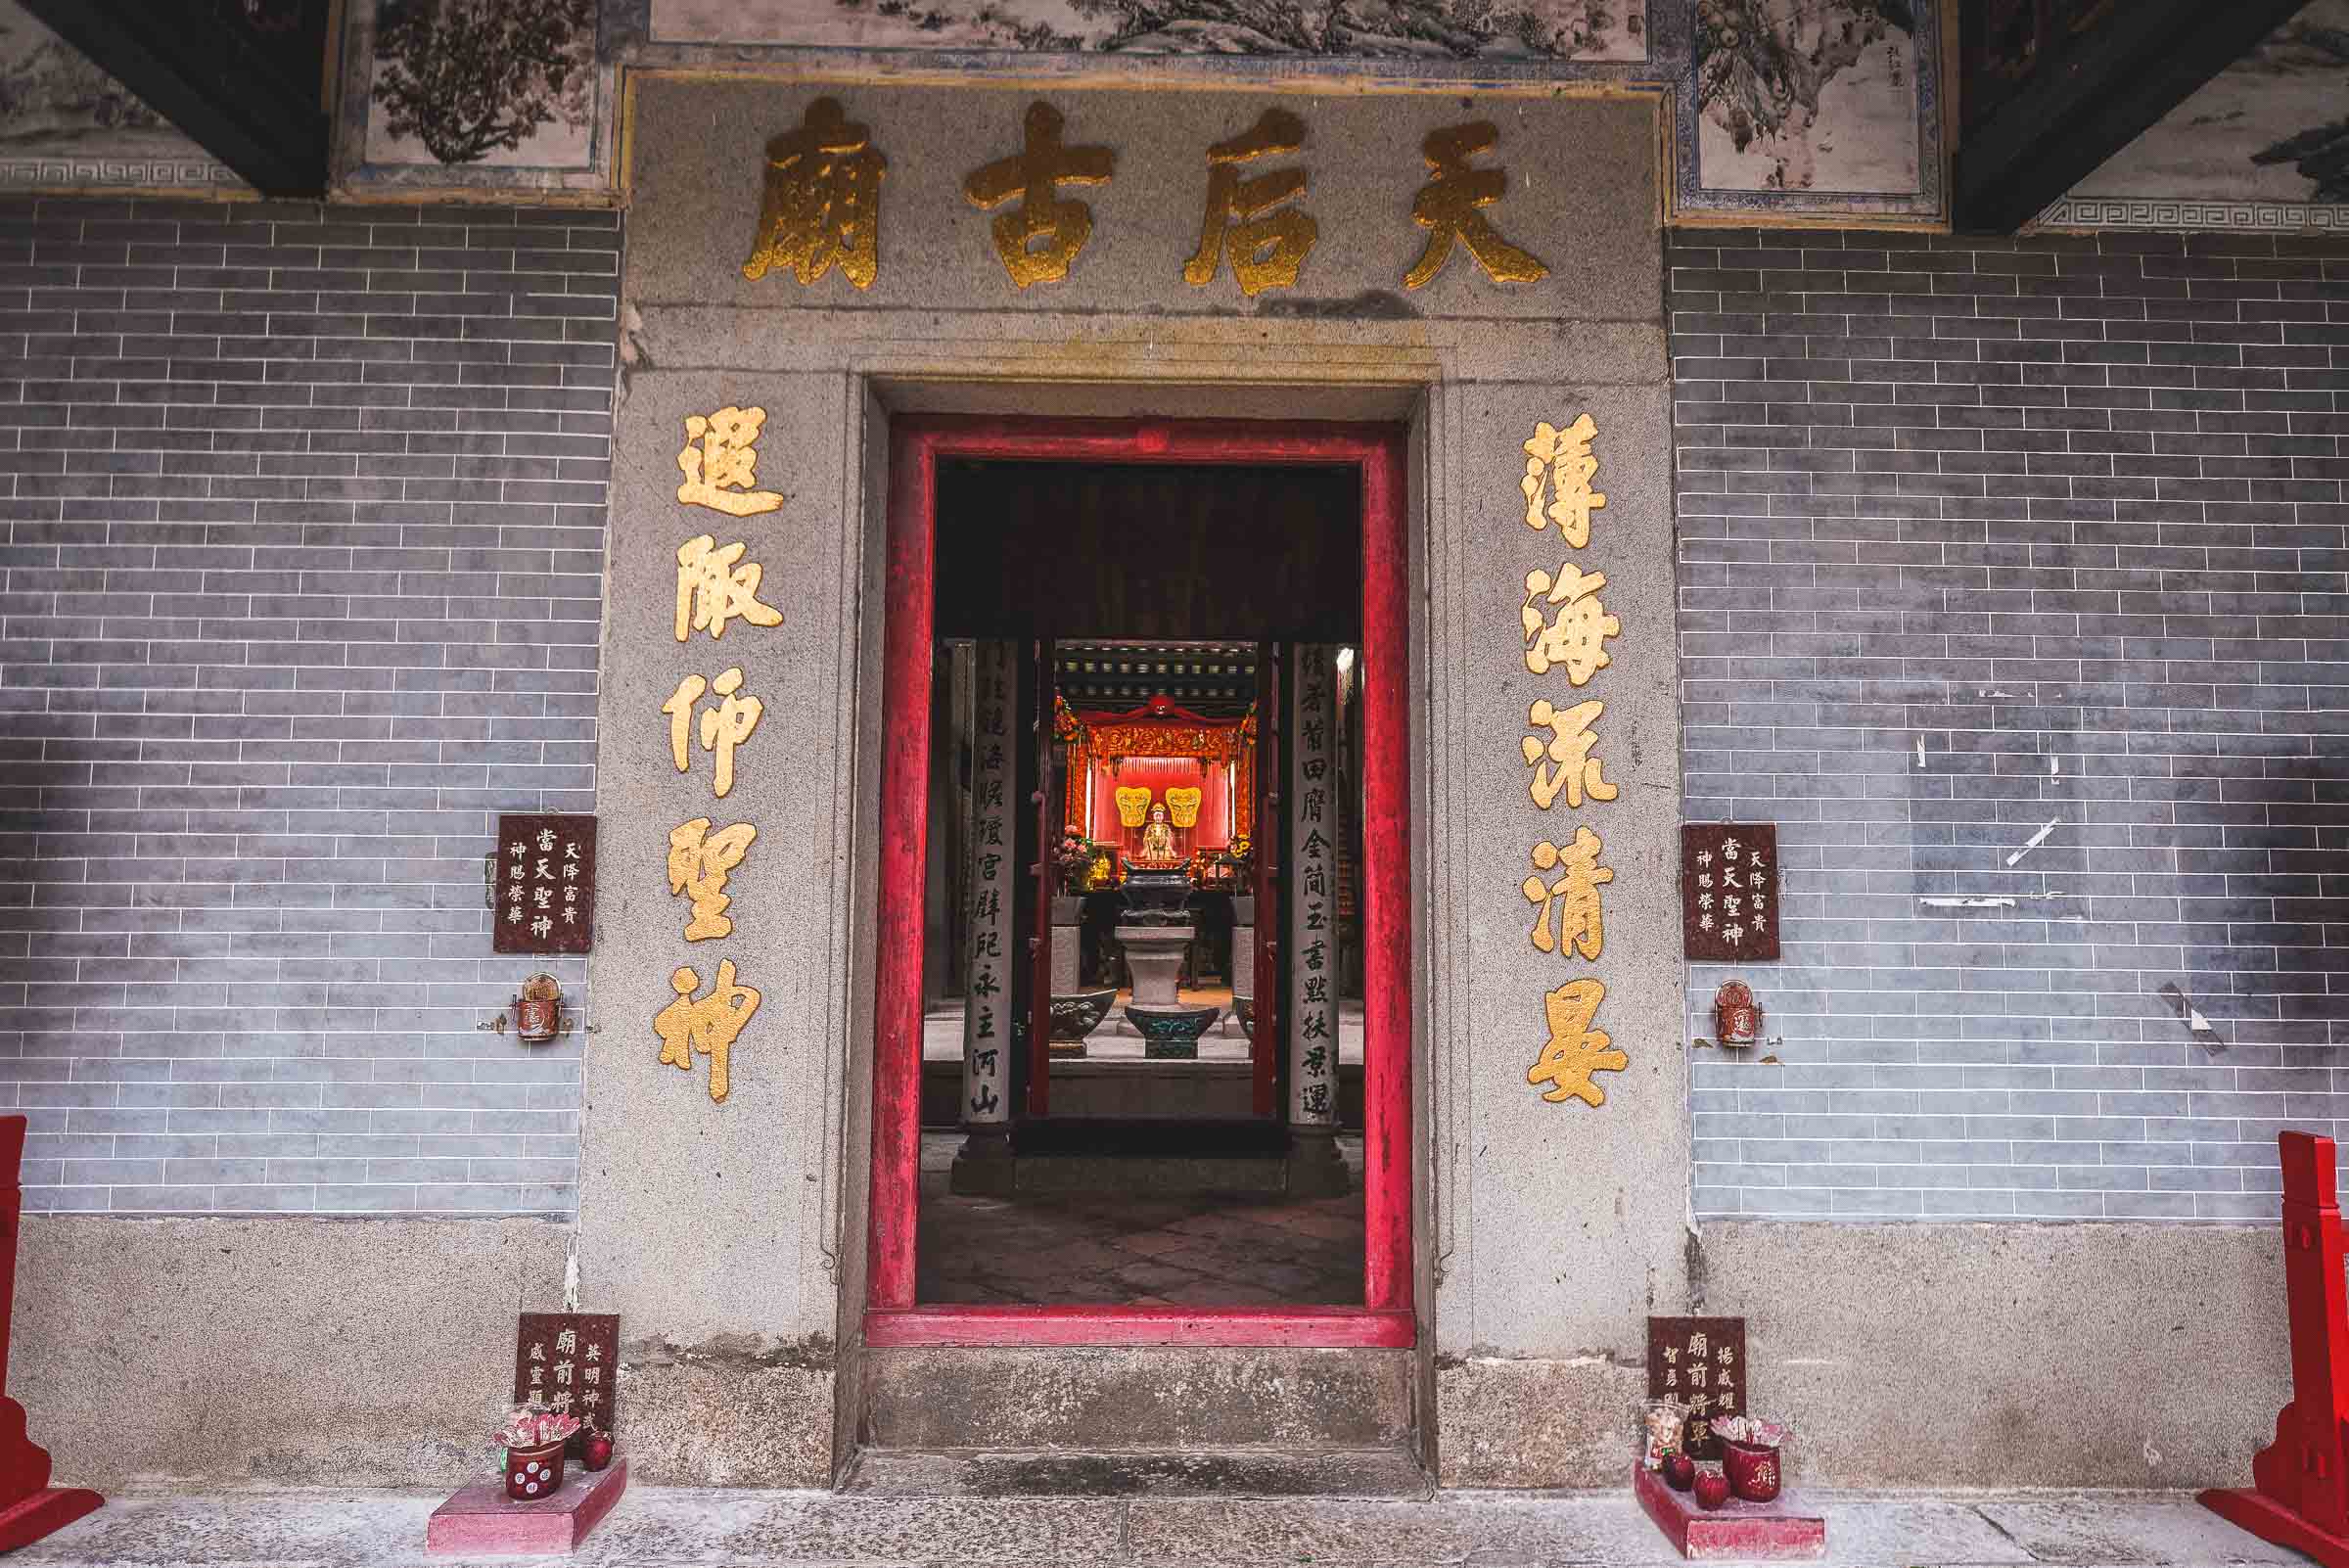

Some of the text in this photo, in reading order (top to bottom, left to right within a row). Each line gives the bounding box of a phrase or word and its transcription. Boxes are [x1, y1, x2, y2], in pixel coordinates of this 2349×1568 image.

[743, 96, 1548, 297] 天后古廟
[507, 842, 528, 925] 神賜榮華
[530, 828, 558, 940] 當天聖神
[562, 842, 580, 925] 天降富貴
[1696, 850, 1715, 932] 神賜榮華
[1721, 837, 1744, 947] 當天聖神
[1749, 851, 1768, 933] 天降富貴
[528, 1342, 547, 1404] 威靈顯
[549, 1328, 576, 1413] 廟前將
[582, 1342, 602, 1431] 英明神武
[1717, 1346, 1734, 1410] 揚威耀
